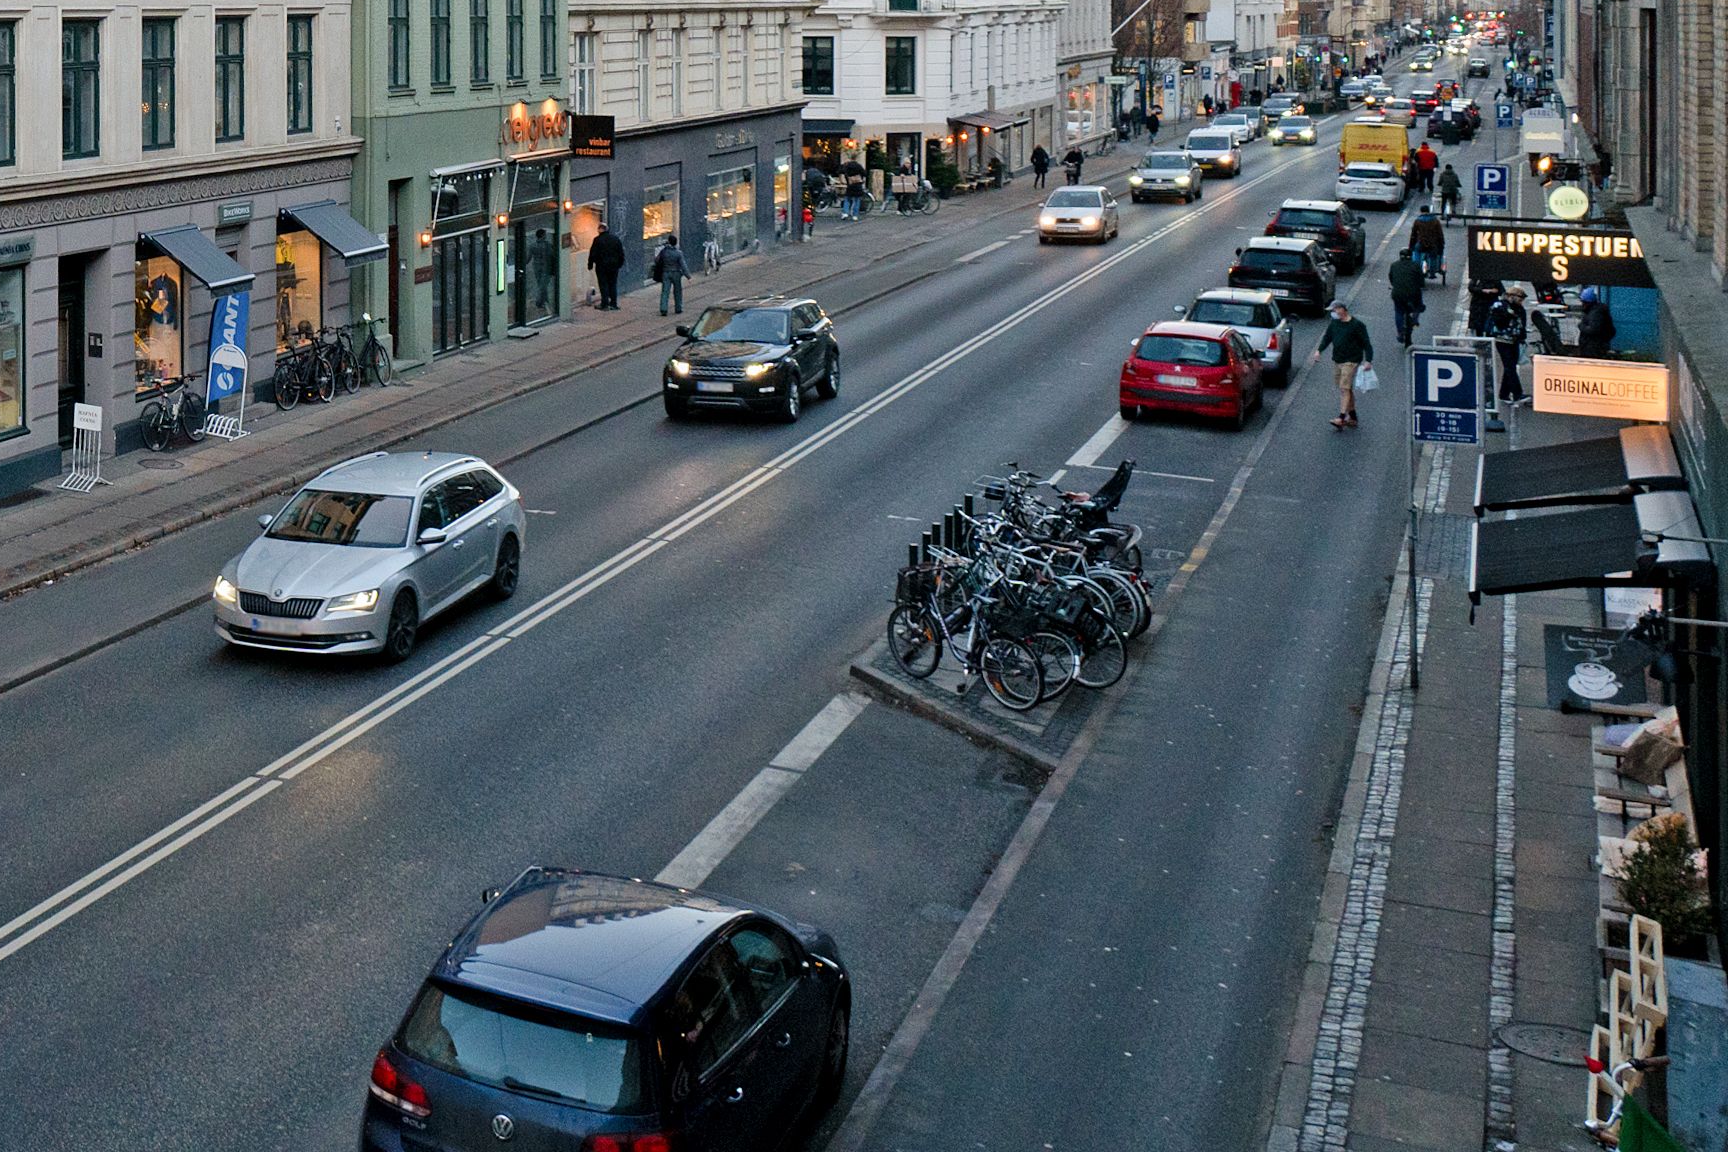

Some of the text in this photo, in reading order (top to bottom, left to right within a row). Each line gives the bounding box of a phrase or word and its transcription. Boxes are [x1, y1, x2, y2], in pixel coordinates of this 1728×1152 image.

[1499, 105, 1510, 118] P
[588, 138, 611, 147] vinbar
[1358, 143, 1390, 151] DHL
[575, 148, 612, 157] restaurant
[1483, 168, 1501, 190] P
[1476, 231, 1645, 259] KLIPPESTUEN
[1551, 255, 1569, 282] S
[1427, 358, 1464, 402] P
